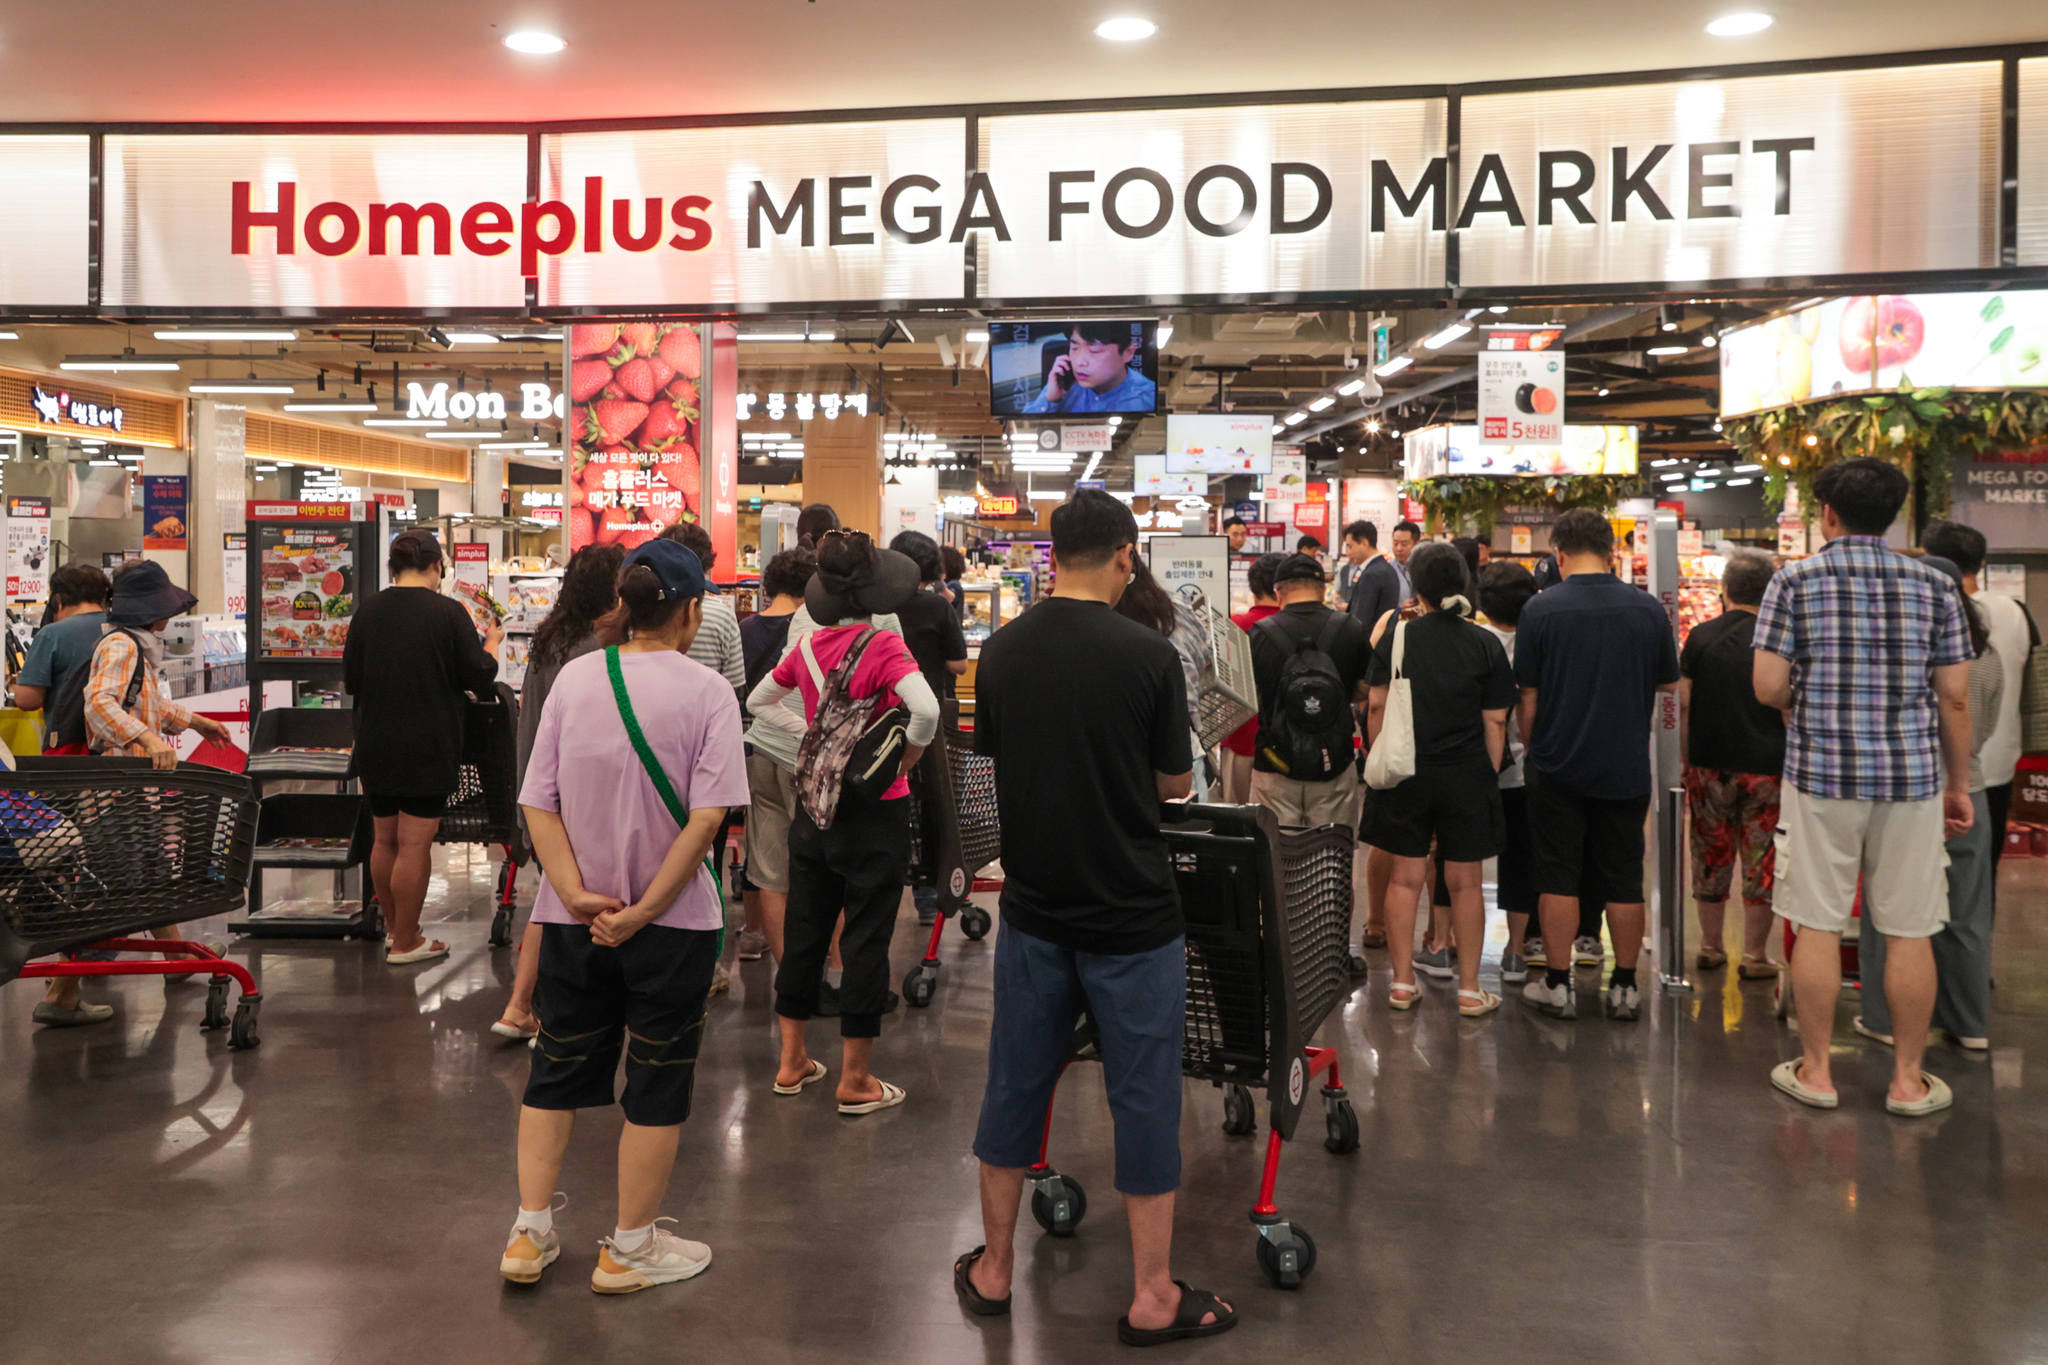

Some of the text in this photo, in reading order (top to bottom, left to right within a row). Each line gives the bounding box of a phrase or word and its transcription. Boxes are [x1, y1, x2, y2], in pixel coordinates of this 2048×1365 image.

[232, 136, 1815, 277] Homeplus MEGA FOOD MARKET
[406, 382, 507, 419] Mon
[1065, 430, 1107, 439] CCTV 녹화중
[1512, 422, 1550, 439] 5천원
[589, 452, 682, 463] 세상 모든 맛이 다 있다!
[602, 469, 669, 489] 홈플러스
[1967, 470, 2018, 484] MEGA
[387, 493, 405, 507] PIZZA
[588, 491, 682, 508] 메가 푸드 마켓
[299, 505, 346, 516] 이번주 전단
[606, 521, 650, 532] Homeplus
[315, 535, 336, 544] NOW
[457, 549, 486, 559] simplus
[1172, 560, 1203, 569] 반려동물
[1165, 571, 1214, 579] 출입제한 안내
[525, 587, 554, 595] simplus
